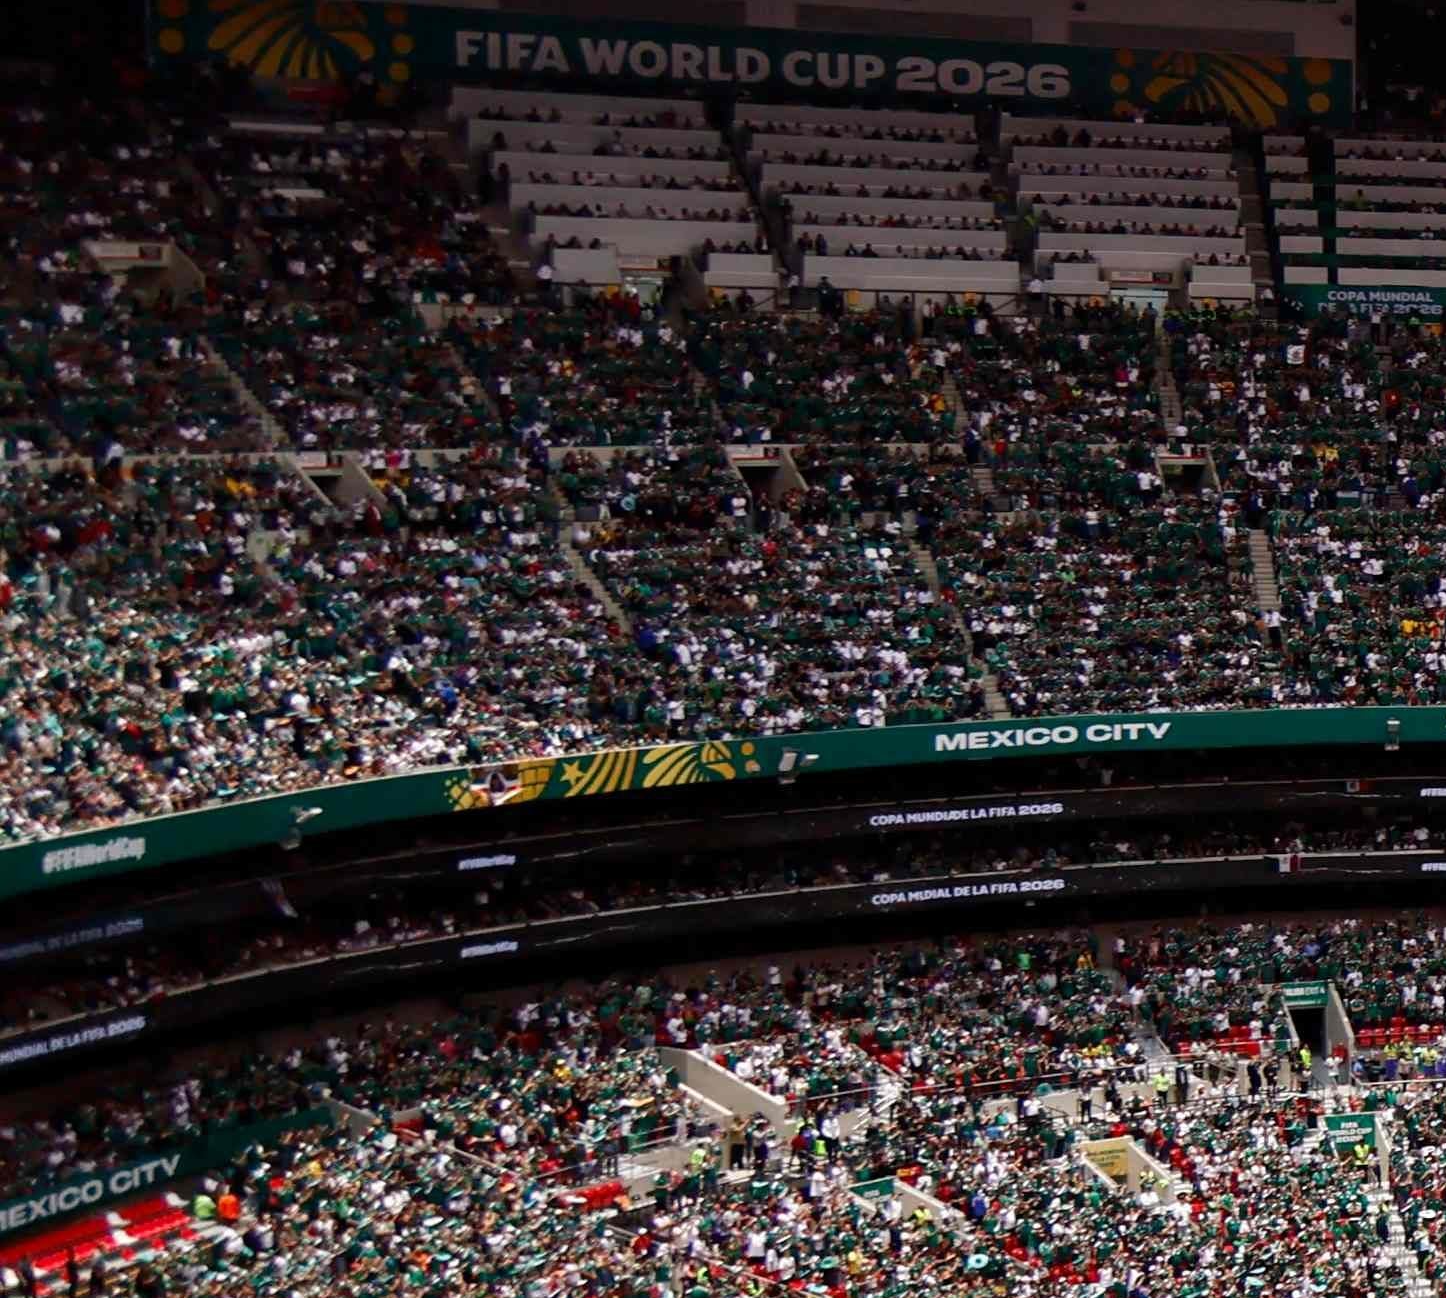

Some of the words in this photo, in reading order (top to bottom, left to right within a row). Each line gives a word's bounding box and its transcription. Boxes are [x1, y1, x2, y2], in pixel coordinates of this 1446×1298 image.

[455, 30, 570, 74] FIFA
[579, 37, 770, 83] WORLD
[781, 50, 885, 89] CUP
[896, 55, 1072, 99] 2026
[1328, 291, 1366, 302] COPA
[1368, 291, 1433, 302] MUNDIAL
[934, 725, 1079, 752] MEXICO
[1086, 721, 1172, 744] CITY
[870, 812, 906, 826] COPA
[971, 809, 987, 819] LA
[989, 807, 1016, 818] FIFA
[1018, 803, 1064, 815] 2026
[872, 893, 906, 905] COPA
[955, 886, 970, 897] DE
[973, 885, 989, 895] LA
[991, 882, 1018, 893] FIFA
[1019, 879, 1065, 891] 2026
[0, 1180, 104, 1233] EXICO
[108, 1153, 181, 1195] CITY
